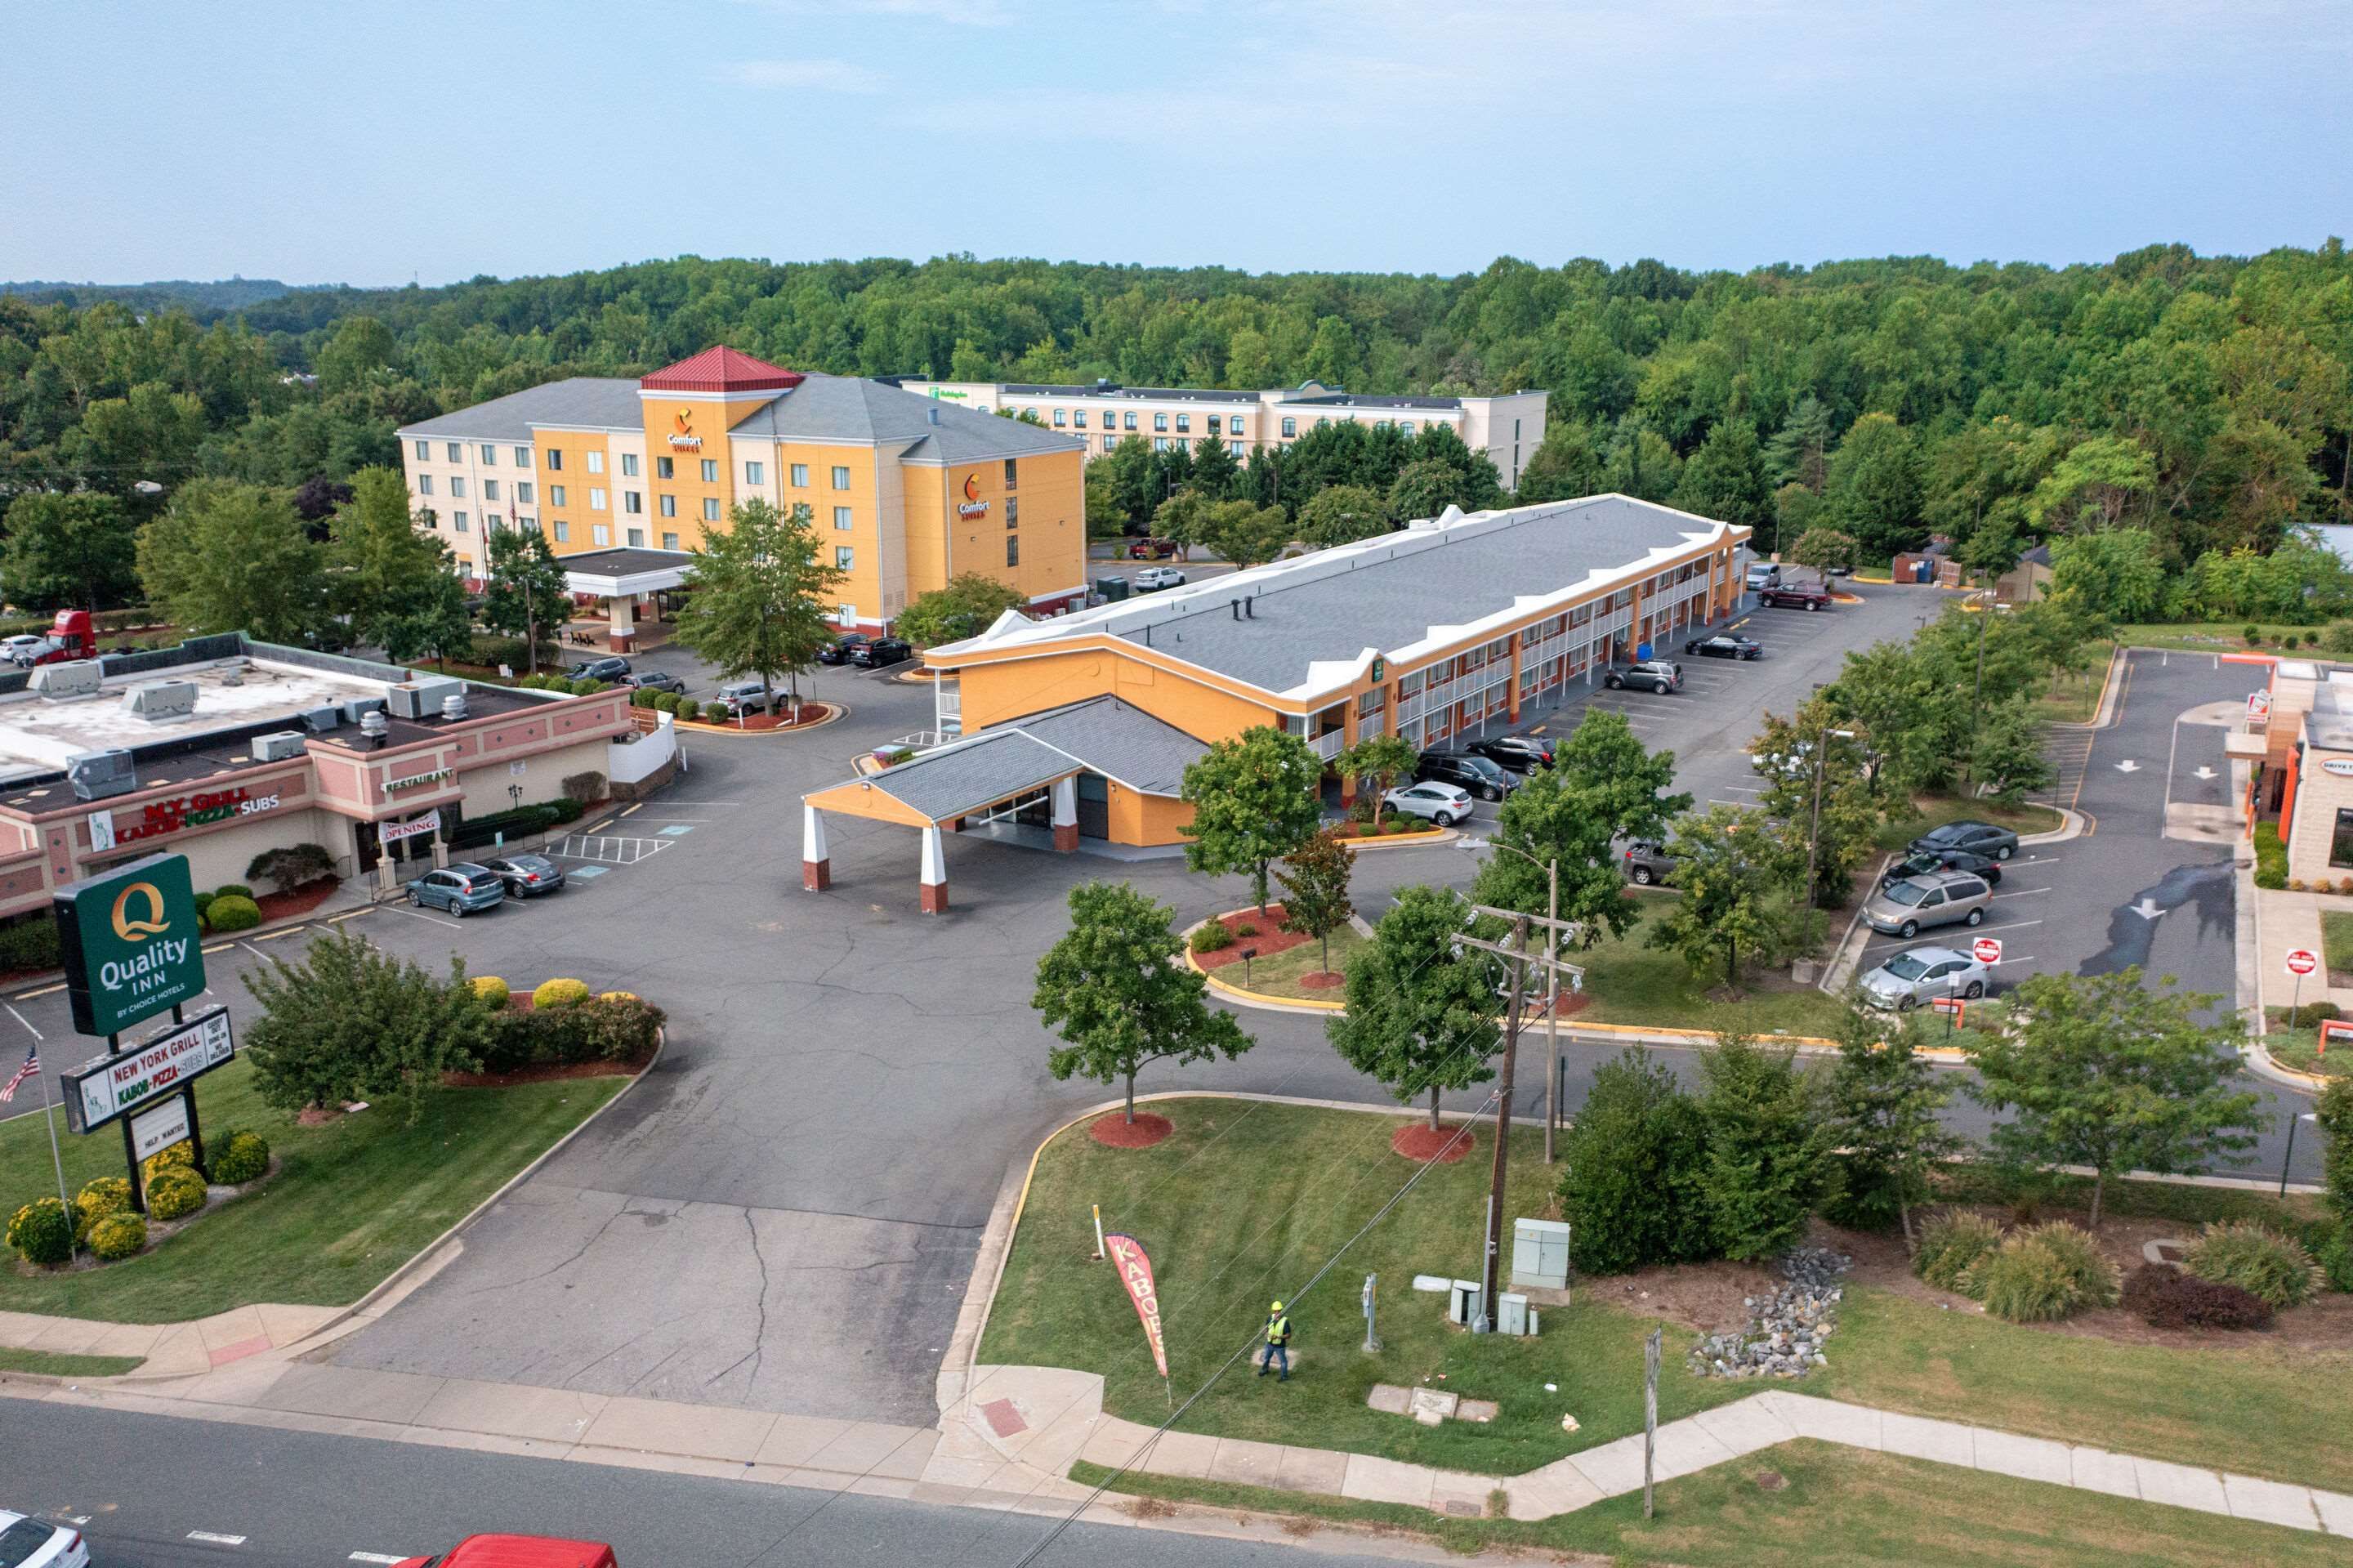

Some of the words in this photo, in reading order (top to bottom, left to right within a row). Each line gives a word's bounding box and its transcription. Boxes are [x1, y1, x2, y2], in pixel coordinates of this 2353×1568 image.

[667, 433, 703, 445] Comfort
[959, 500, 990, 514] Comfort
[385, 768, 454, 793] RESTAURANT
[190, 788, 250, 811] GRILL
[240, 794, 279, 815] SUBS
[386, 820, 435, 840] OPENING
[100, 937, 188, 991] Quality
[132, 970, 167, 995] INN
[117, 1008, 127, 1019] BY
[128, 995, 157, 1013] CHOICE
[157, 982, 186, 1001] HOTELS
[114, 1061, 138, 1084] NEW
[140, 1051, 169, 1071] YORK
[170, 1034, 200, 1057] GRILL
[145, 1137, 159, 1149] HELP
